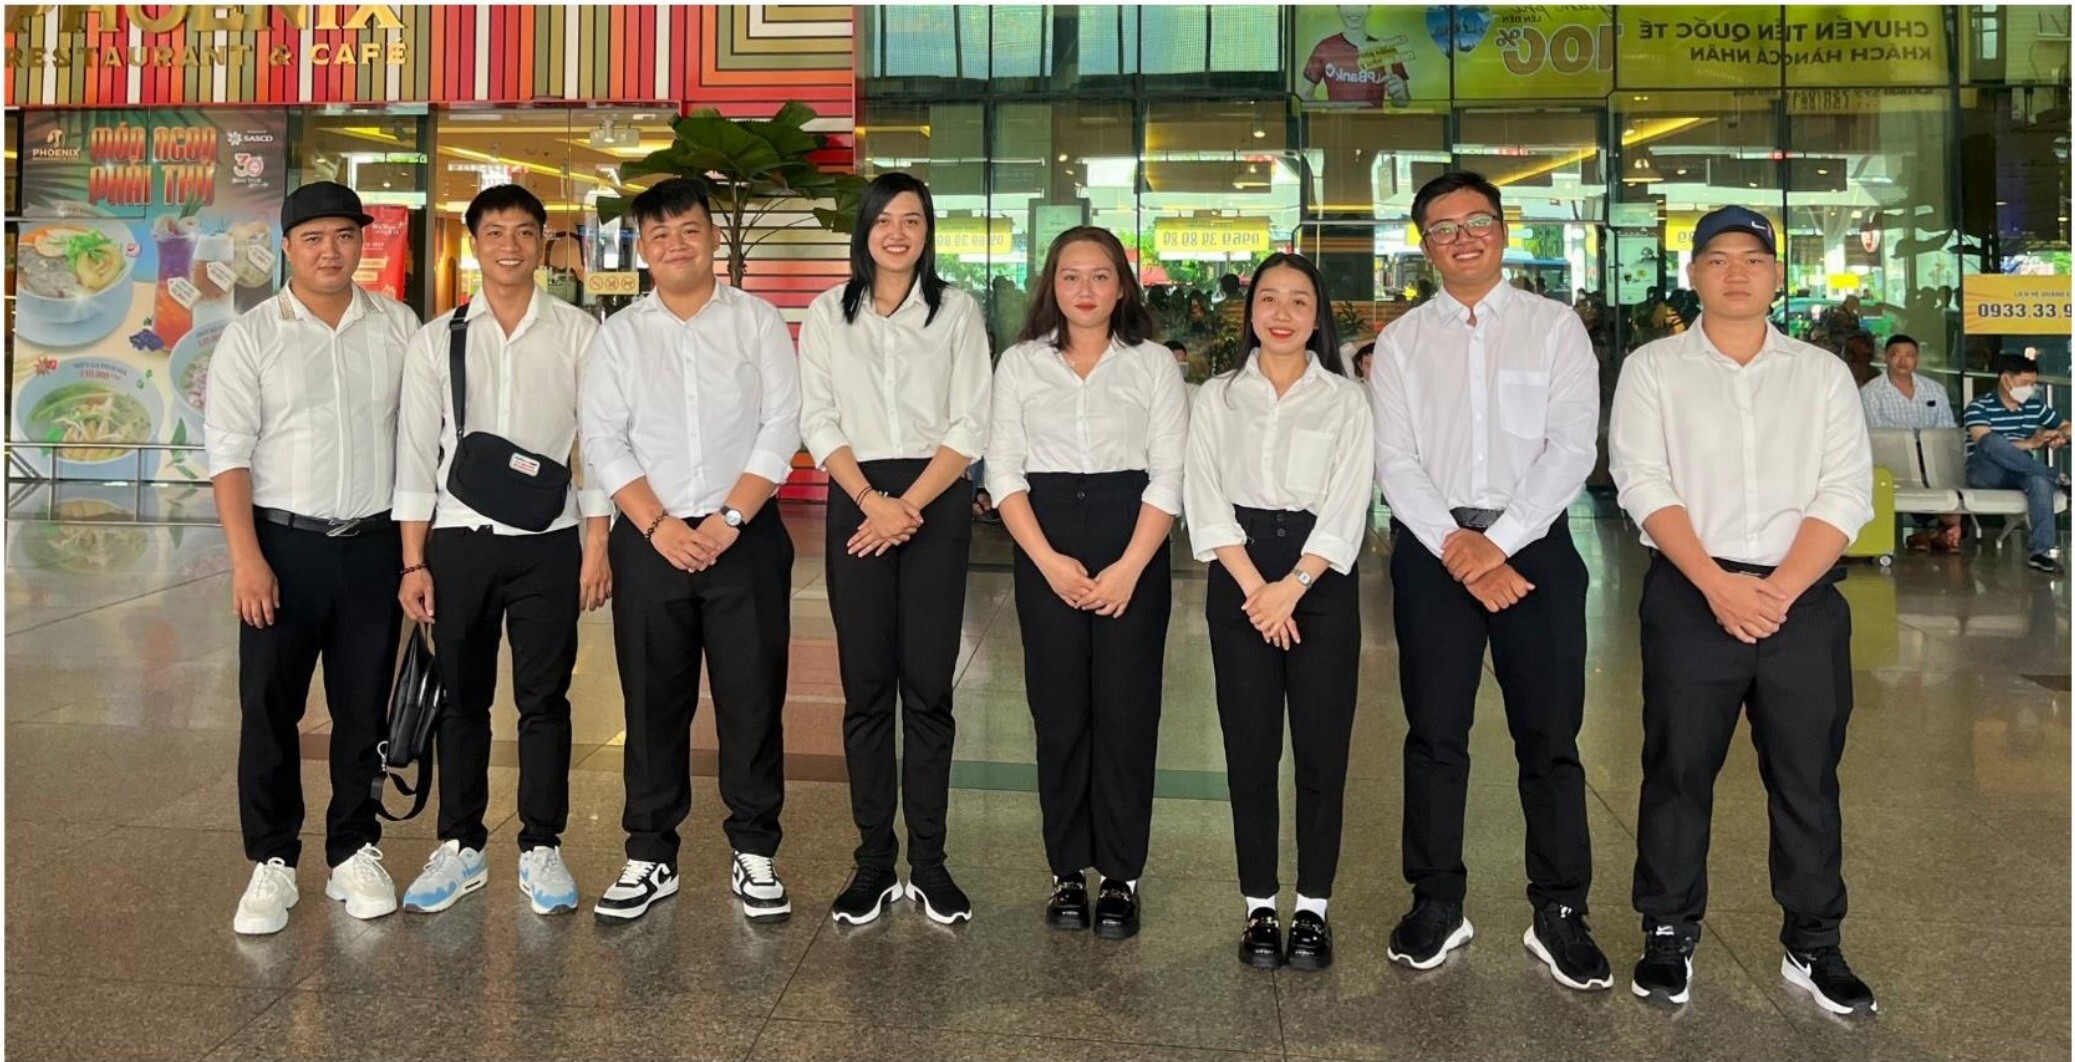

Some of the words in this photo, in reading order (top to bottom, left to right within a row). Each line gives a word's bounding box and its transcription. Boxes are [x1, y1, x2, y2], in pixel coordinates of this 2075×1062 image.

[5, 44, 253, 68] RESTAURANT
[270, 44, 294, 66] &
[310, 38, 407, 66] CAFÉ
[32, 148, 79, 157] PHOENIX
[1978, 303, 2072, 318] 0933.33.9
